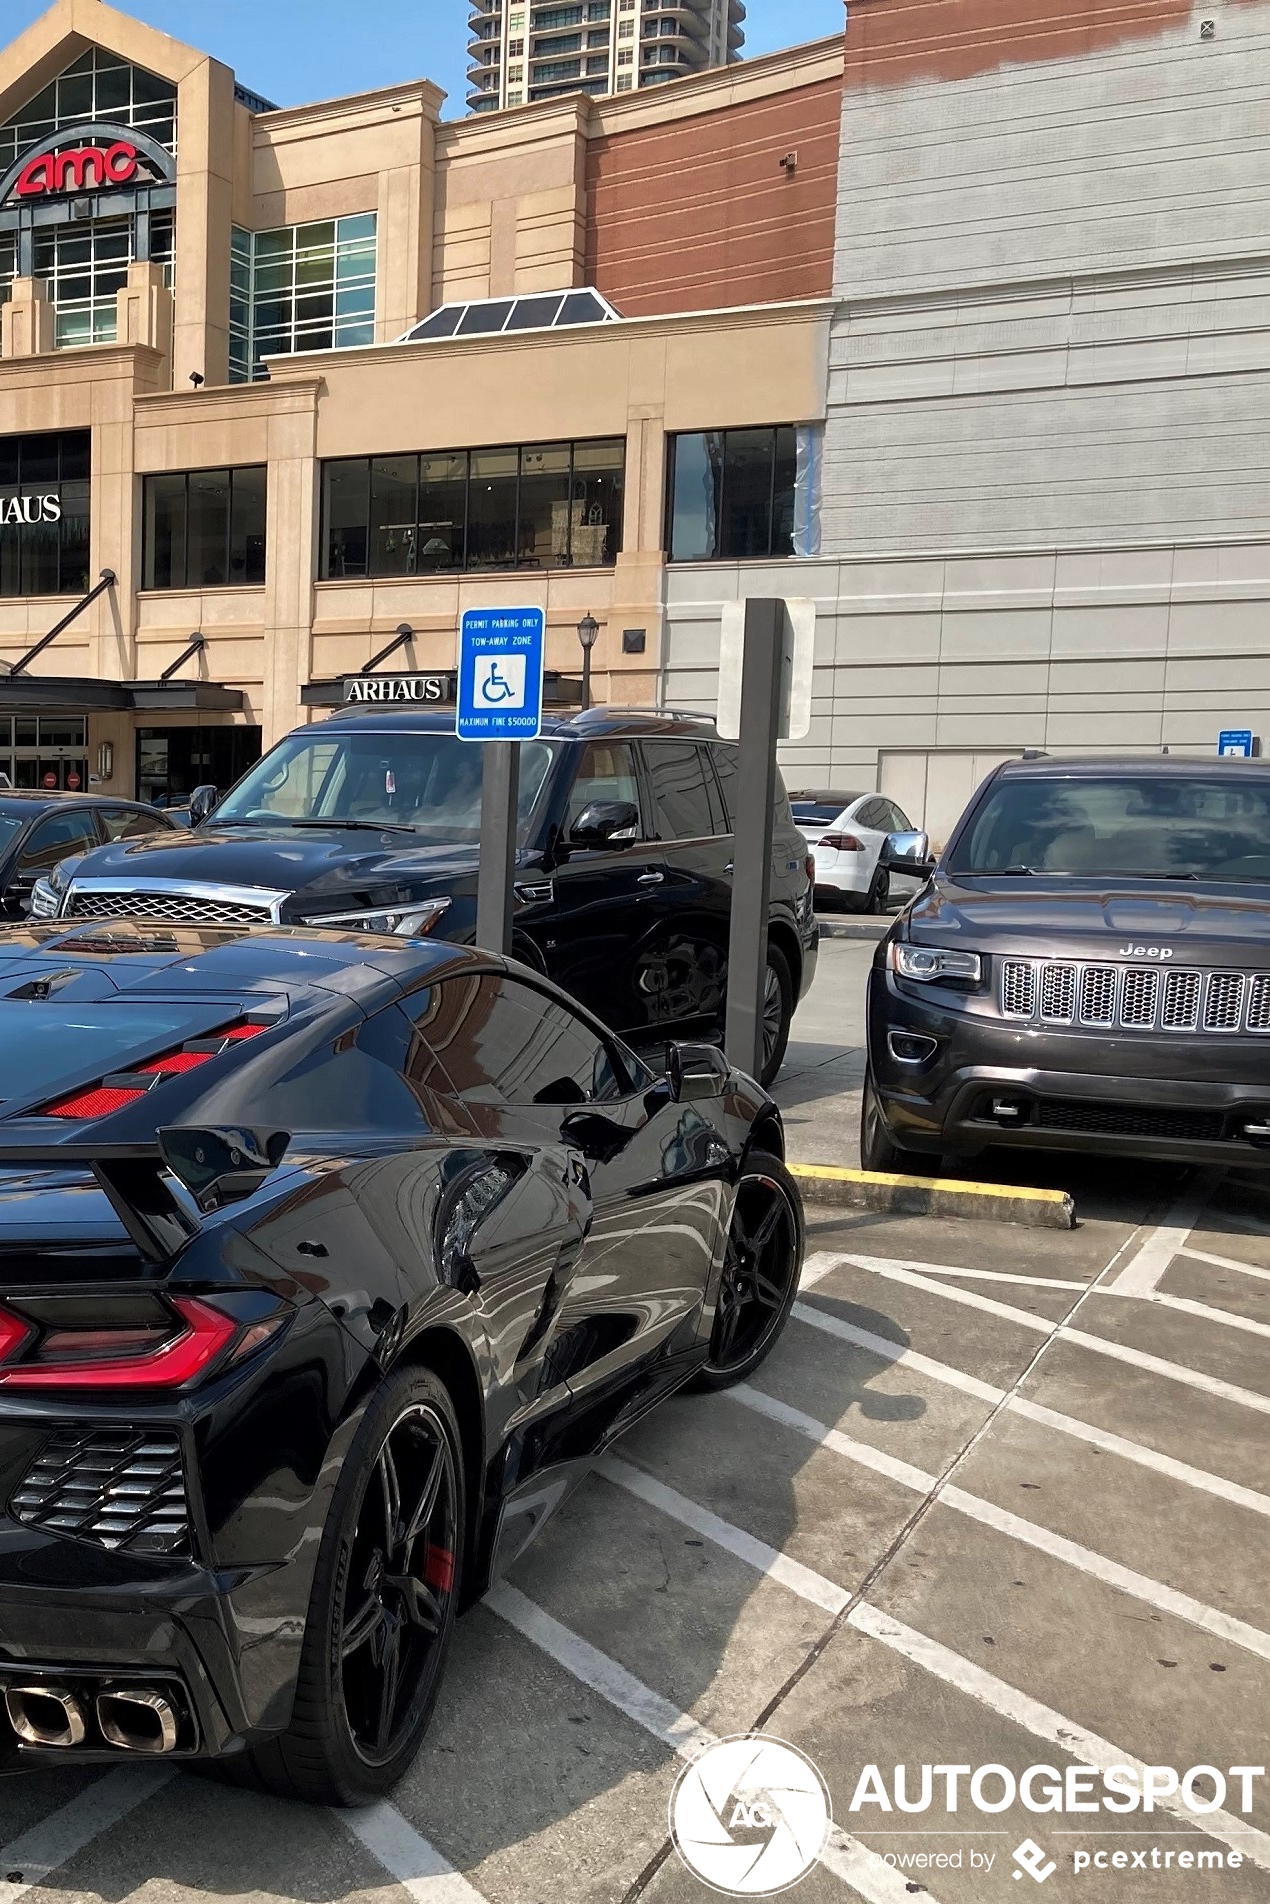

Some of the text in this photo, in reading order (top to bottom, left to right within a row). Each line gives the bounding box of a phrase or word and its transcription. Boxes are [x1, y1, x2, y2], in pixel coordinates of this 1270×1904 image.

[465, 618, 539, 629] PERMIT PARKING ONLY
[471, 636, 532, 646] TOW-AWAY ZONE
[346, 680, 441, 701] ARHAUS
[460, 717, 489, 726] MAXIMUM
[492, 717, 505, 726] FINE
[1119, 943, 1173, 961] Jeep
